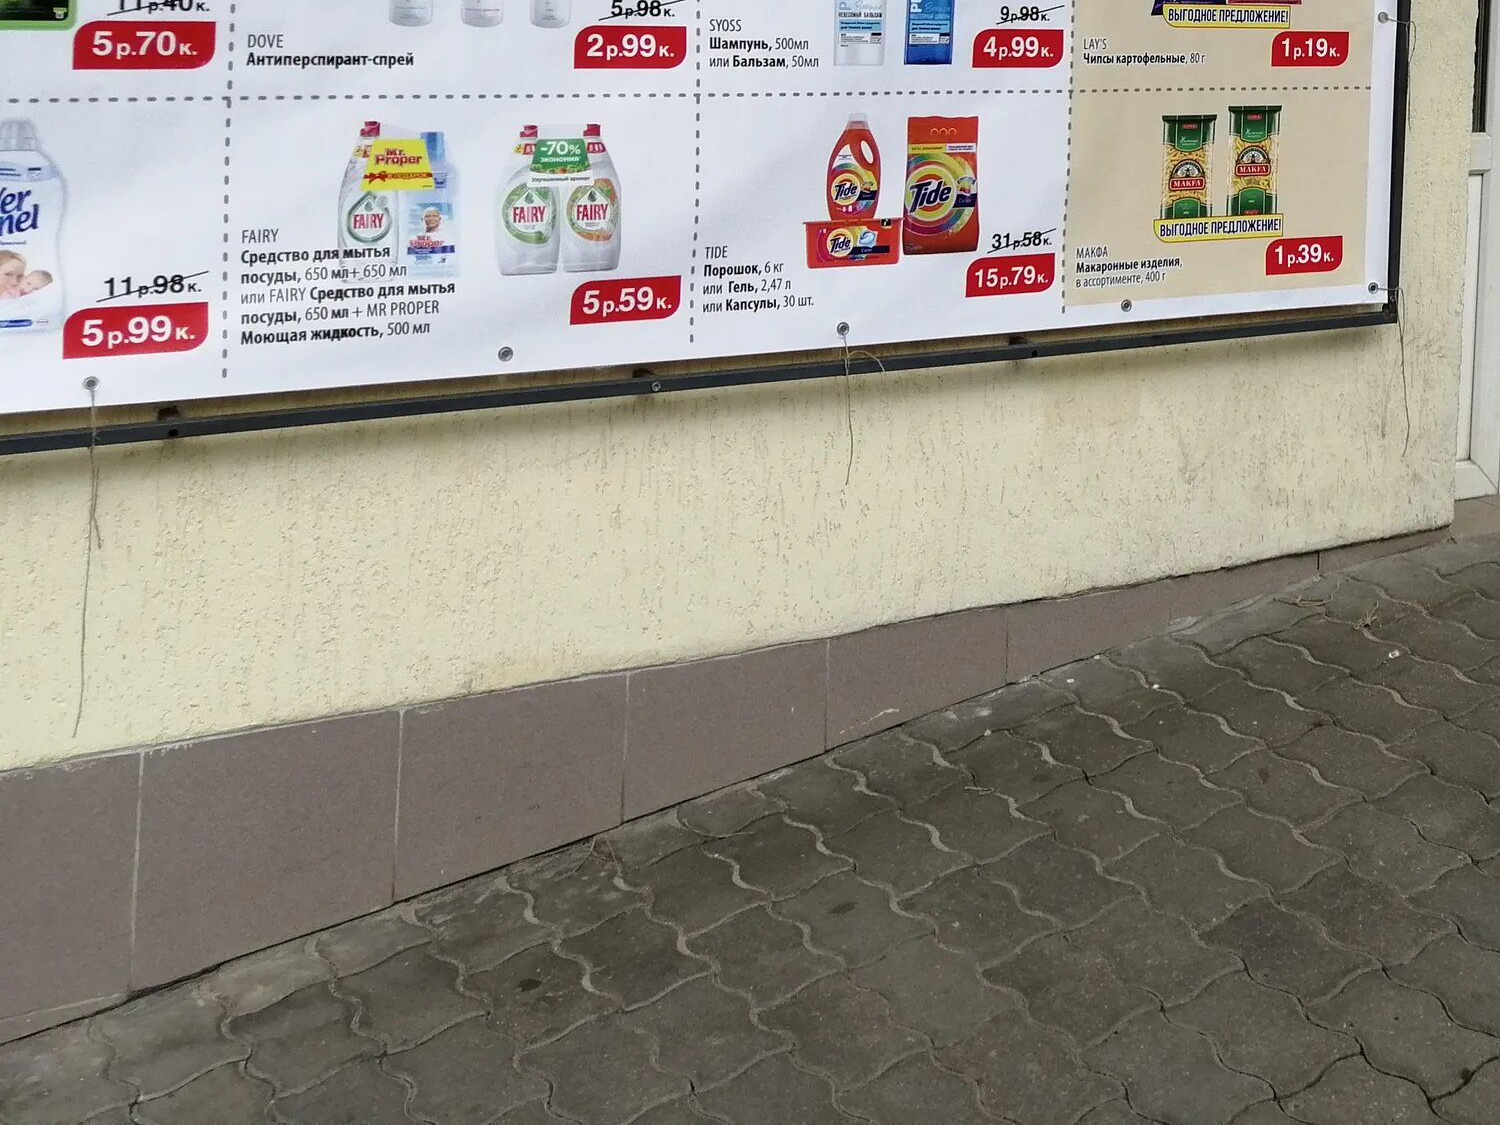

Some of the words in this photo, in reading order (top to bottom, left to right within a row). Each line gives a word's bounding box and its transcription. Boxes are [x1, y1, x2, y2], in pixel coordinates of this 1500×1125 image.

[1168, 7, 1217, 23] ВЫГОДНОЕ
[1218, 8, 1289, 24] ПРЕДЛОЖЕНИЕ!
[709, 18, 742, 32] SYOSS
[247, 33, 284, 49] DOVE
[709, 36, 772, 52] Шампунь,
[775, 37, 809, 50] 500мл
[1083, 38, 1107, 50] LAY'S
[246, 51, 414, 69] Антиперспирант-спрей
[709, 57, 730, 68] или
[732, 56, 790, 70] Бальзам,
[792, 55, 819, 68] 50мл
[1083, 52, 1115, 66] Чипсы
[1116, 53, 1188, 66] картофельные,
[540, 141, 581, 156] -70%
[834, 182, 858, 201] Tide
[909, 180, 952, 214] Tide
[353, 213, 384, 229] FAIRY
[513, 206, 546, 224] FAIRY
[576, 204, 608, 222] FAIRY
[241, 228, 280, 244] FAIRY
[1160, 221, 1208, 238] ВЫГОДНОЕ
[1210, 218, 1281, 235] ПРЕДЛОЖЕНИЕ!
[241, 248, 310, 266] Средство
[312, 249, 340, 263] для
[343, 246, 391, 260] мытья
[705, 246, 728, 259] TIDE
[1076, 246, 1108, 260] МАКФА
[703, 263, 762, 278] Порошок,
[773, 262, 784, 275] кг
[1076, 260, 1139, 275] Макаронные
[1140, 257, 1183, 271] изделия,
[241, 271, 301, 287] посуды,
[304, 266, 329, 281] 650
[363, 263, 387, 279] 650
[389, 265, 407, 277] мл
[1083, 273, 1144, 289] ассортименте,
[1145, 271, 1160, 283] 400
[240, 292, 265, 304] или
[269, 287, 306, 302] FAIRY
[309, 286, 374, 303] Средство
[377, 286, 404, 300] для
[407, 282, 456, 295] мытья
[702, 283, 723, 295] или
[728, 281, 758, 295] Гель,
[761, 278, 784, 293] 2,47
[241, 311, 302, 327] посуды,
[305, 306, 329, 321] 650
[331, 308, 349, 319] мл
[366, 302, 387, 317] MR
[390, 299, 440, 315] PROPER
[702, 302, 723, 314] или
[725, 296, 780, 314] Капсулы,
[783, 296, 796, 308] 30
[797, 296, 814, 307] шт.
[241, 328, 307, 346] Моющая
[310, 325, 384, 342] жидкость,
[386, 321, 410, 336] 500
